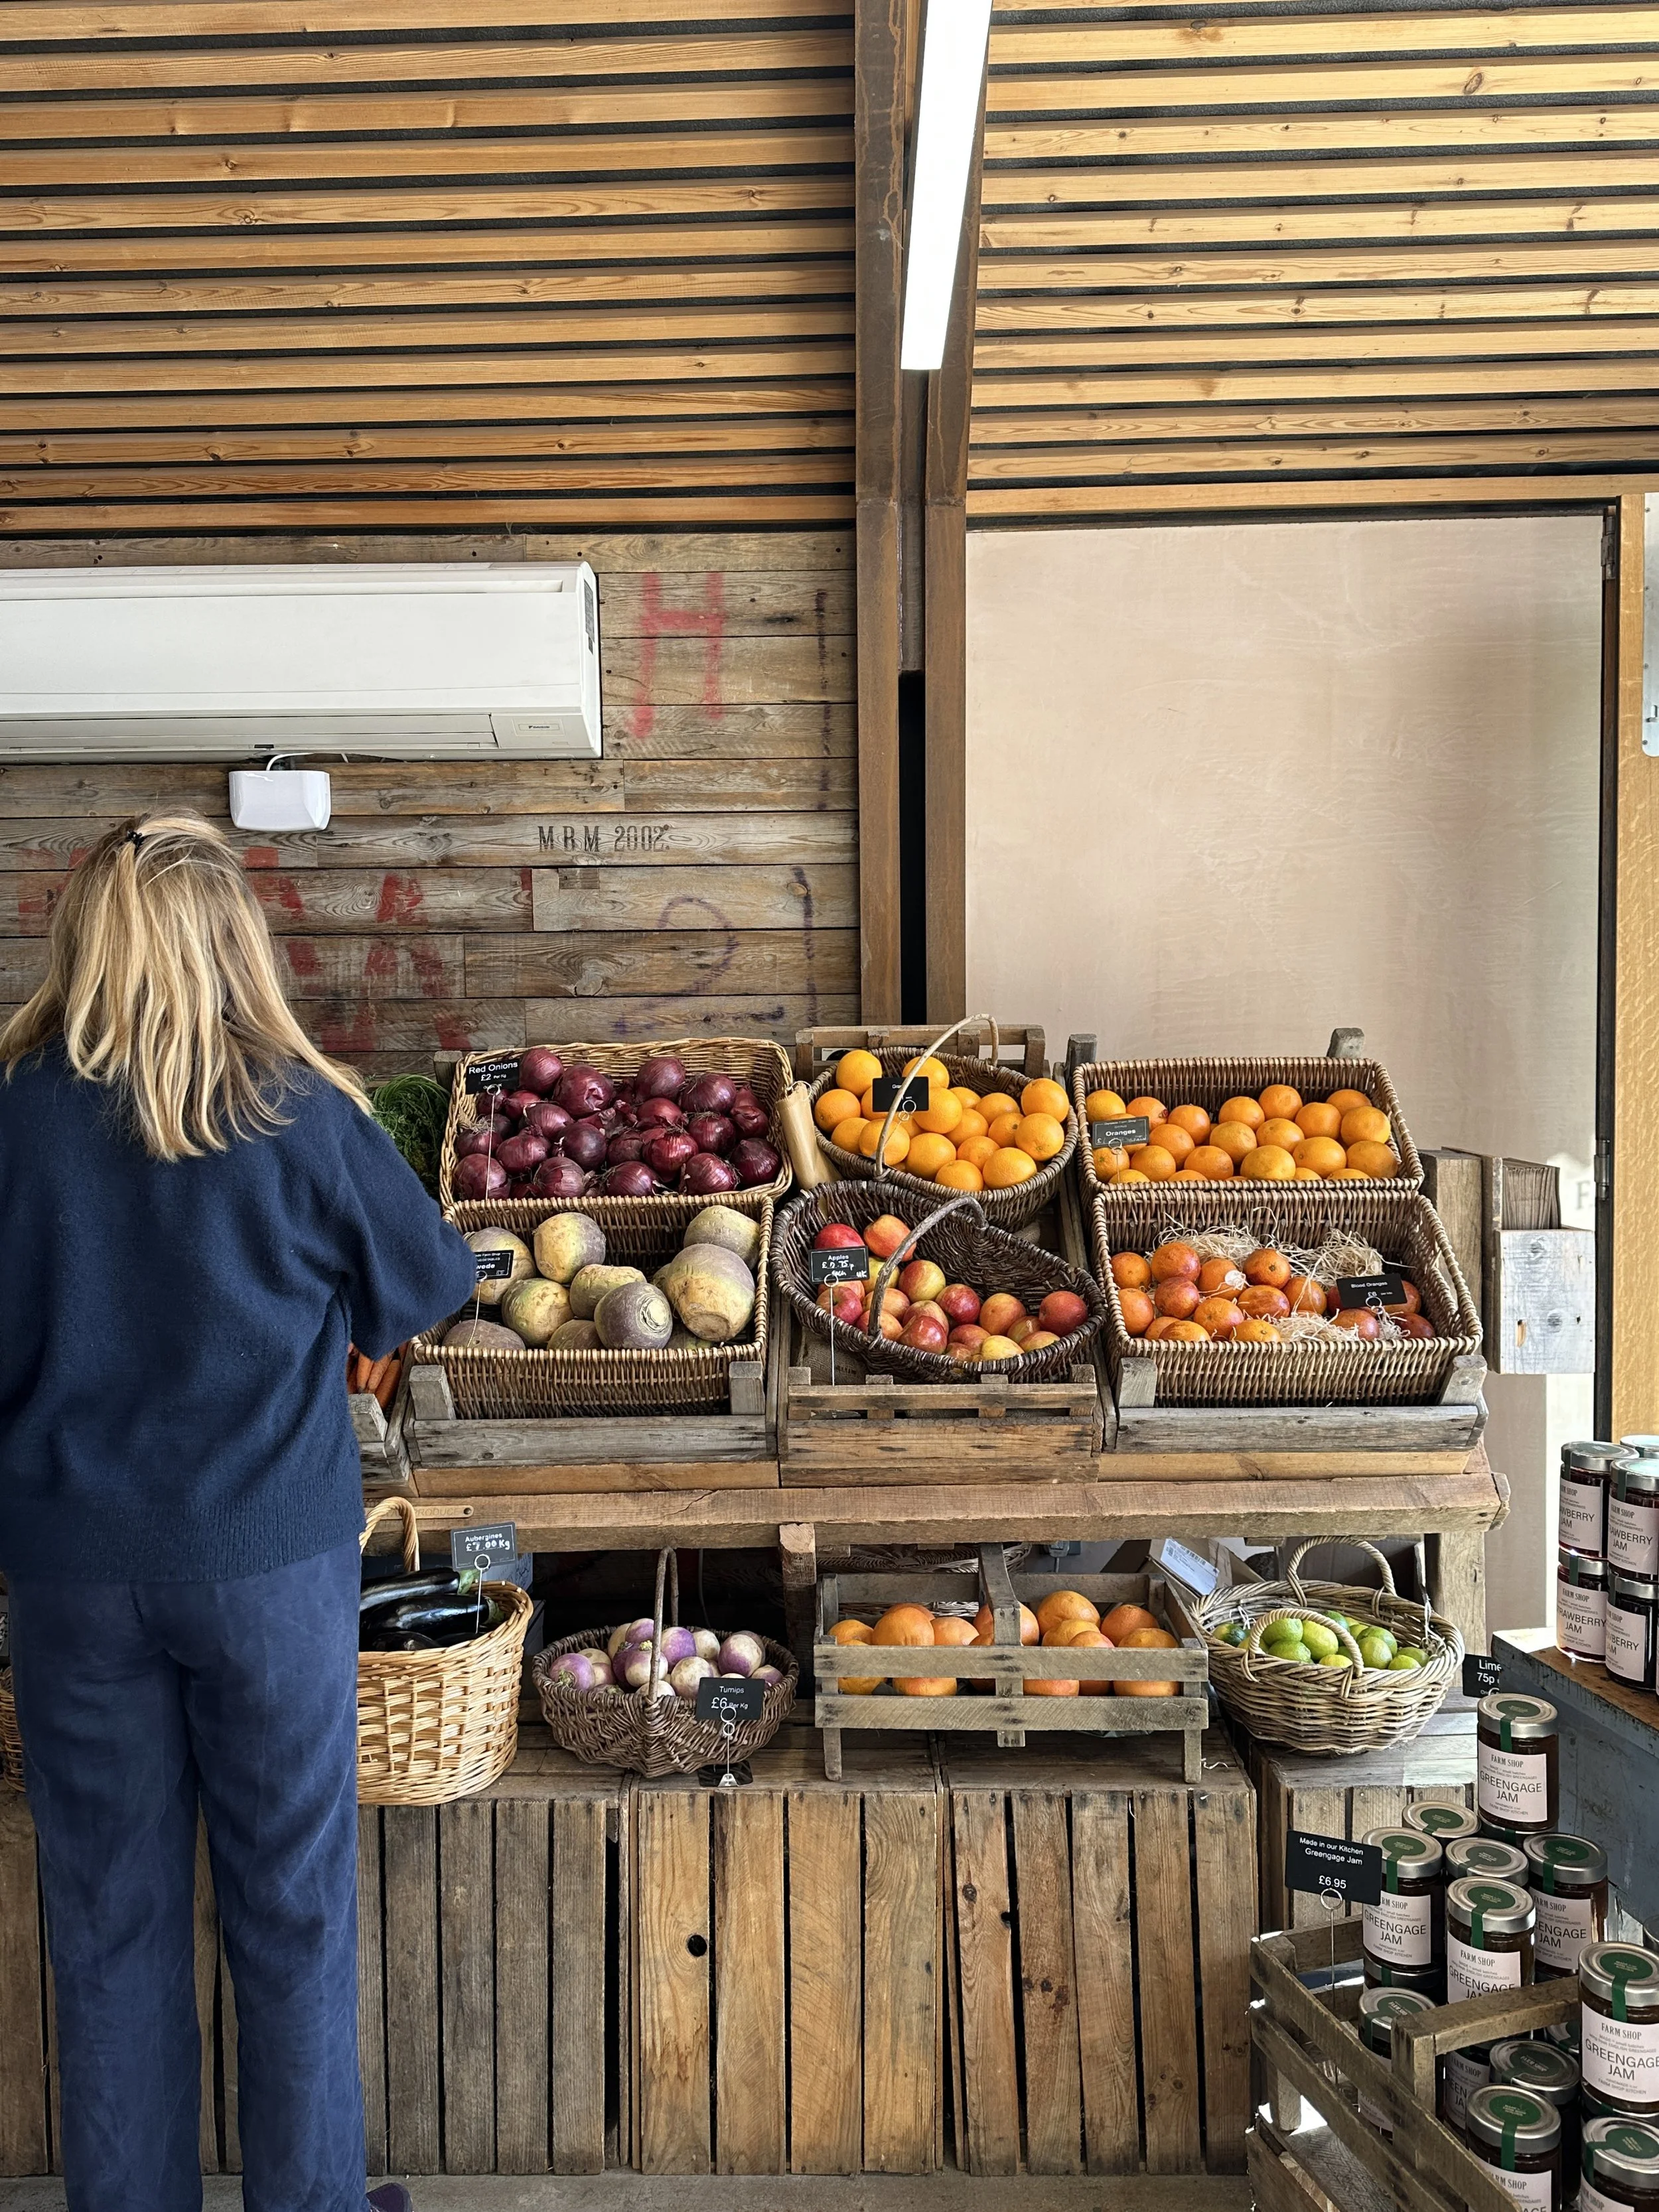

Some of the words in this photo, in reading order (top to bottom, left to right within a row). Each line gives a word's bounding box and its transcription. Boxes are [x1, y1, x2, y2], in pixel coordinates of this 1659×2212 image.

[469, 1066, 486, 1074] Red
[488, 1062, 518, 1071] Onions
[1621, 1509, 1635, 1518] SHOP
[465, 1533, 502, 1542] Aubergines
[1613, 1538, 1627, 1552] JAM
[1575, 1593, 1589, 1602] SHOP
[1565, 1621, 1582, 1634] JAM
[1477, 1672, 1495, 1685] 75p
[719, 1686, 745, 1694] Turnips
[711, 1697, 728, 1709] £6
[1491, 1754, 1506, 1765] FARM
[1508, 1759, 1524, 1768] SHOP
[1480, 1770, 1542, 1793] GREENGAGE
[1497, 1790, 1518, 1803] JAM
[1299, 1837, 1318, 1846] Made
[1339, 1845, 1364, 1856] Kitchen
[1305, 1848, 1345, 1862] Greengage
[1347, 1856, 1363, 1866] Jam
[1319, 1875, 1346, 1889] £6.95
[1382, 1897, 1390, 1907] RM
[1392, 1901, 1408, 1909] SHOP
[1534, 1895, 1548, 1909] FARM
[1550, 1902, 1567, 1912] SHOP
[1364, 1909, 1427, 1935] GREENGAGE
[1536, 1921, 1587, 1939] ENGAGE
[1380, 1931, 1402, 1945] JAM
[1539, 1933, 1561, 1949] JAM
[1460, 1949, 1477, 1962] FARM
[1478, 1956, 1496, 1967] SHOP
[1449, 1965, 1515, 1992] GREENGAGE
[1465, 1988, 1482, 1999] JA
[1601, 2022, 1621, 2037] FARM
[1623, 2029, 1642, 2040] SHOP
[1465, 2065, 1482, 2078] SHOP
[1608, 2064, 1634, 2081] JAM
[1494, 2175, 1506, 2187] RM
[1508, 2179, 1528, 2190] SHOP
